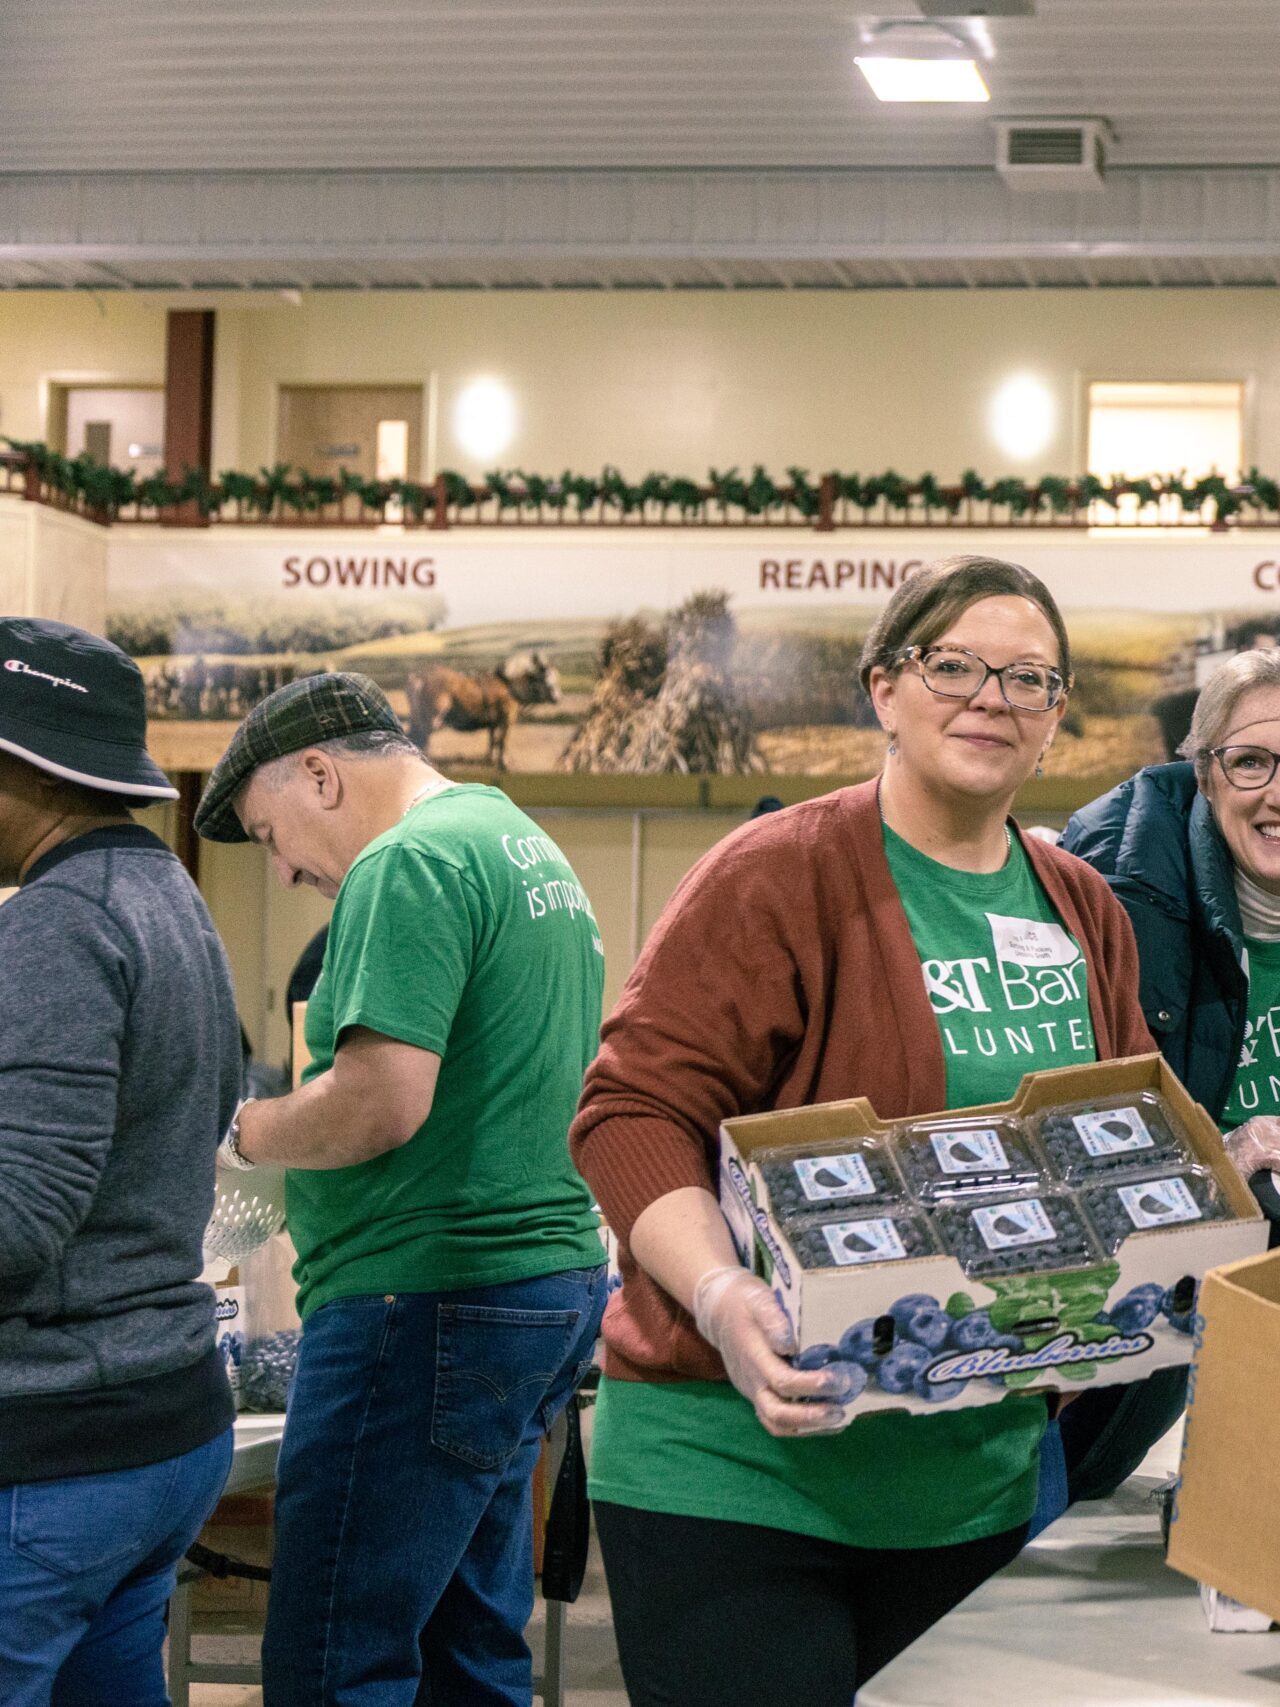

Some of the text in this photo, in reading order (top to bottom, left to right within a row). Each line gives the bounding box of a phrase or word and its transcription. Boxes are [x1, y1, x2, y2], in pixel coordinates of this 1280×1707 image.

[284, 557, 435, 587] SOWING
[4, 659, 89, 693] Champion
[522, 880, 547, 919] is
[944, 1018, 1094, 1056] LUNTE
[929, 1334, 1150, 1381] Blueberries
